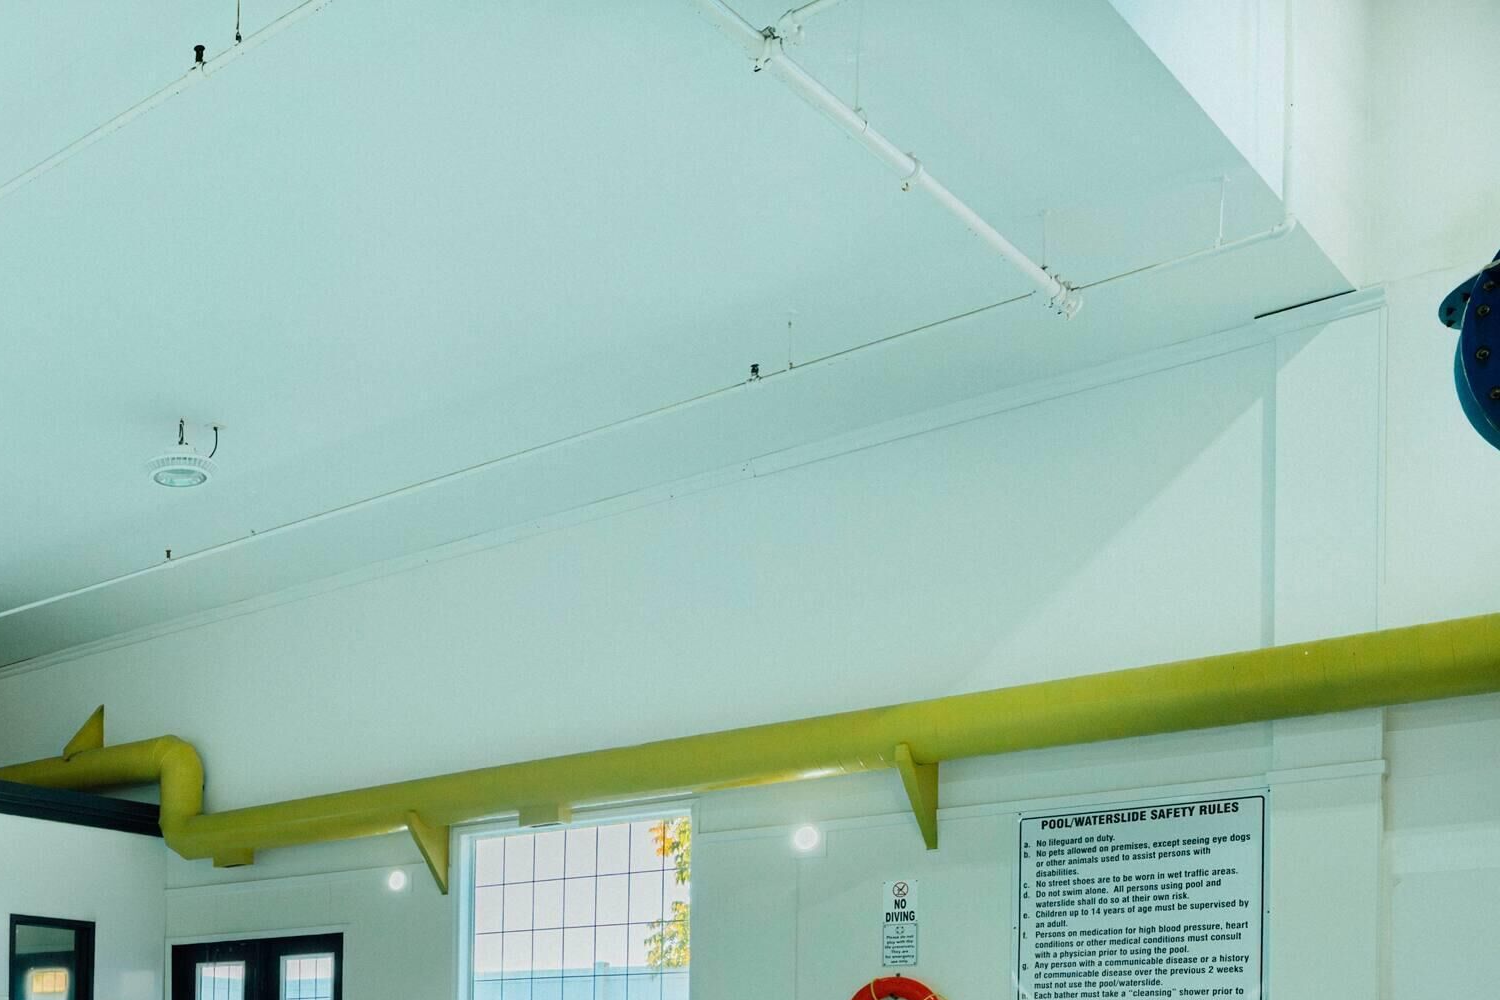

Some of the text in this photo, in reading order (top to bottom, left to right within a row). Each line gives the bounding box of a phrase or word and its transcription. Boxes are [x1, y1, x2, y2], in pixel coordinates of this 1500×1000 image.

[1041, 801, 1239, 830] POOL/WATERSLIDE SAFETY RULES
[1048, 834, 1116, 847] lifeguard duty.
[1048, 833, 1251, 858] pets allowed premises, except seeing dogs
[1045, 846, 1211, 867] other animals assist persons with
[1035, 868, 1080, 878] disabilities.
[1048, 868, 1239, 888] street shoes worn traffic areas.
[1062, 881, 1183, 897] swim alone. persons using
[894, 898, 906, 910] NO
[1035, 891, 1190, 908] waterslide shall their risk.
[885, 911, 915, 922] DIVING
[1035, 899, 1236, 919] Children years must supervised
[1035, 920, 1249, 939] Persons medication high blood pressure, heart
[1046, 919, 1068, 928] adult.
[1034, 931, 1242, 949] conditions other medical conditions must consult
[1034, 947, 1152, 960] with physician prior using
[1050, 954, 1250, 970] person with communicable disease history
[1043, 964, 1244, 979] communicable disease over previous weeks
[1033, 977, 1163, 990] must pool/waterslide.
[1033, 991, 1052, 1000] Each
[1053, 991, 1079, 999] bather
[1080, 990, 1100, 999] must
[1101, 989, 1119, 998] take
[1179, 987, 1210, 996] shower
[1212, 986, 1233, 997] prior
